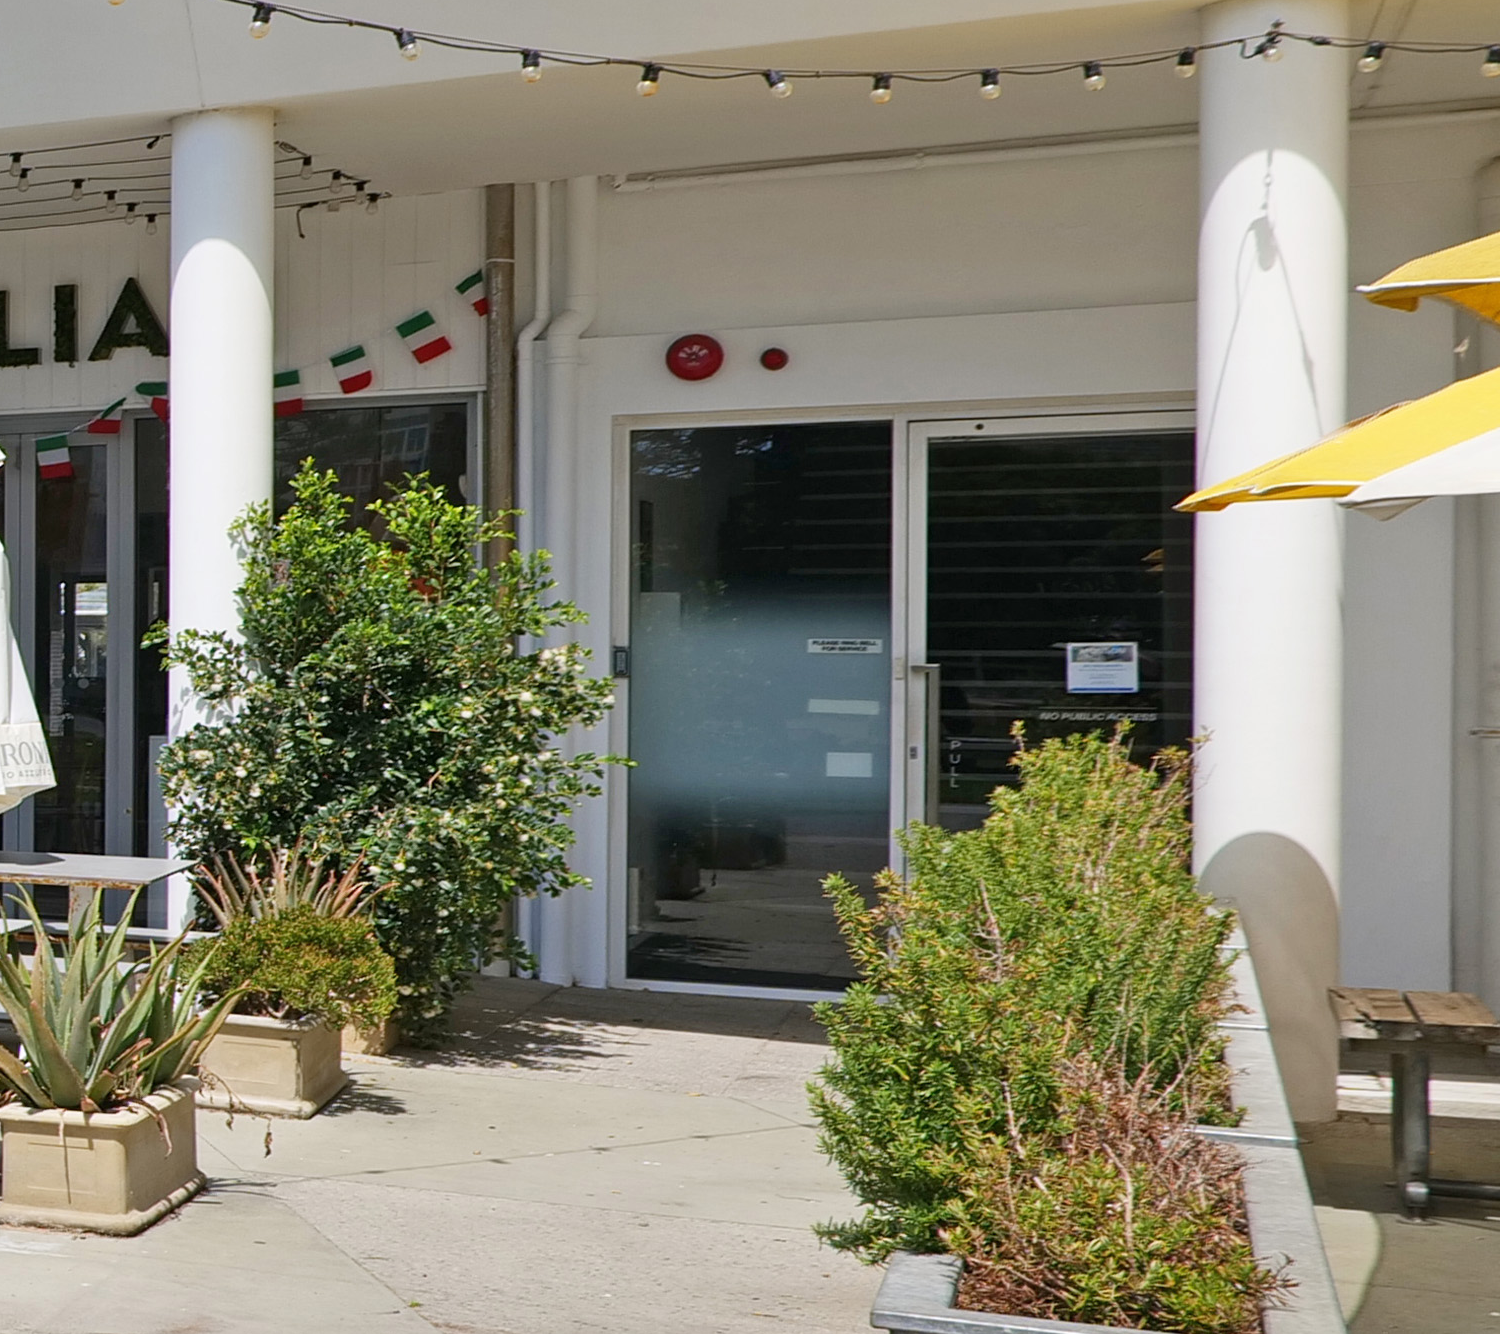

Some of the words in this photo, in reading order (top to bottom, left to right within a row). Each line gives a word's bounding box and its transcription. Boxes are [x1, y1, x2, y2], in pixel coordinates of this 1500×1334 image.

[1040, 712, 1059, 720] NO
[1060, 712, 1105, 721] PUBLIC
[1105, 712, 1157, 721] ACCESS
[951, 740, 961, 787] PULL
